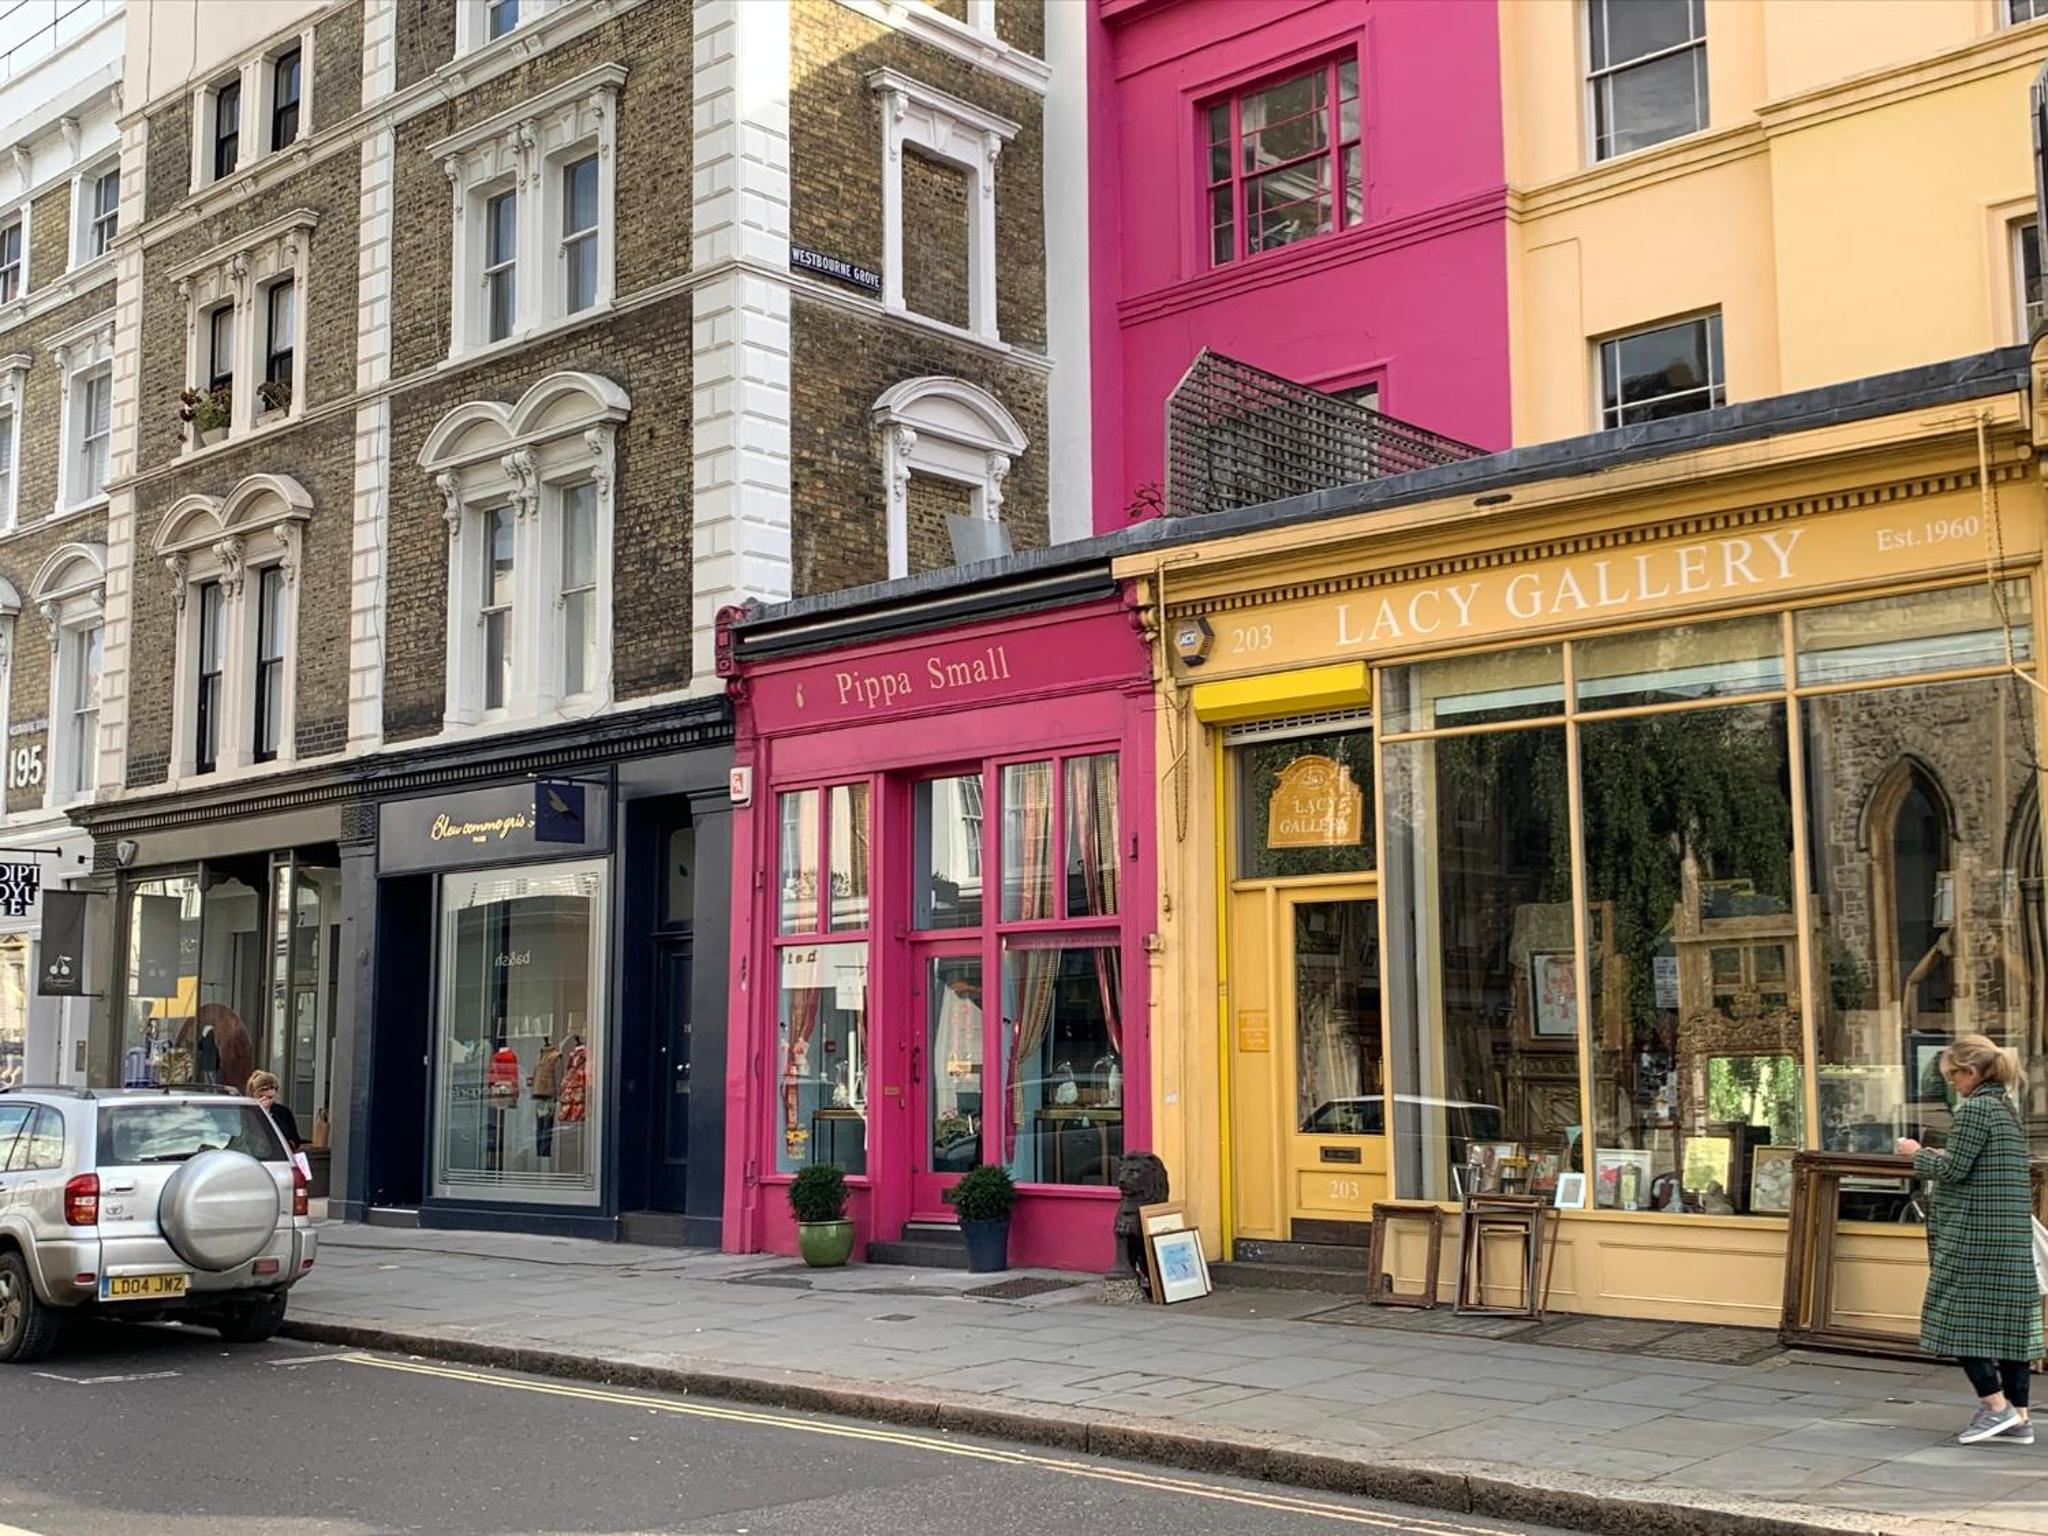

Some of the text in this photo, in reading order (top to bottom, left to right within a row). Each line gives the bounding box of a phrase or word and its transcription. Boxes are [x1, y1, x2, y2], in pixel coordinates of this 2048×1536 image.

[791, 247, 880, 288] WESTBOURNE GROVE
[1925, 515, 1979, 544] 1960
[1335, 529, 1807, 647] LACY GALLERY
[1231, 625, 1272, 654] 203
[835, 646, 1011, 709] Pippa Small
[9, 745, 43, 789] 195
[10, 898, 23, 915] E
[1329, 1180, 1359, 1201] 203
[111, 1278, 149, 1295] LD04
